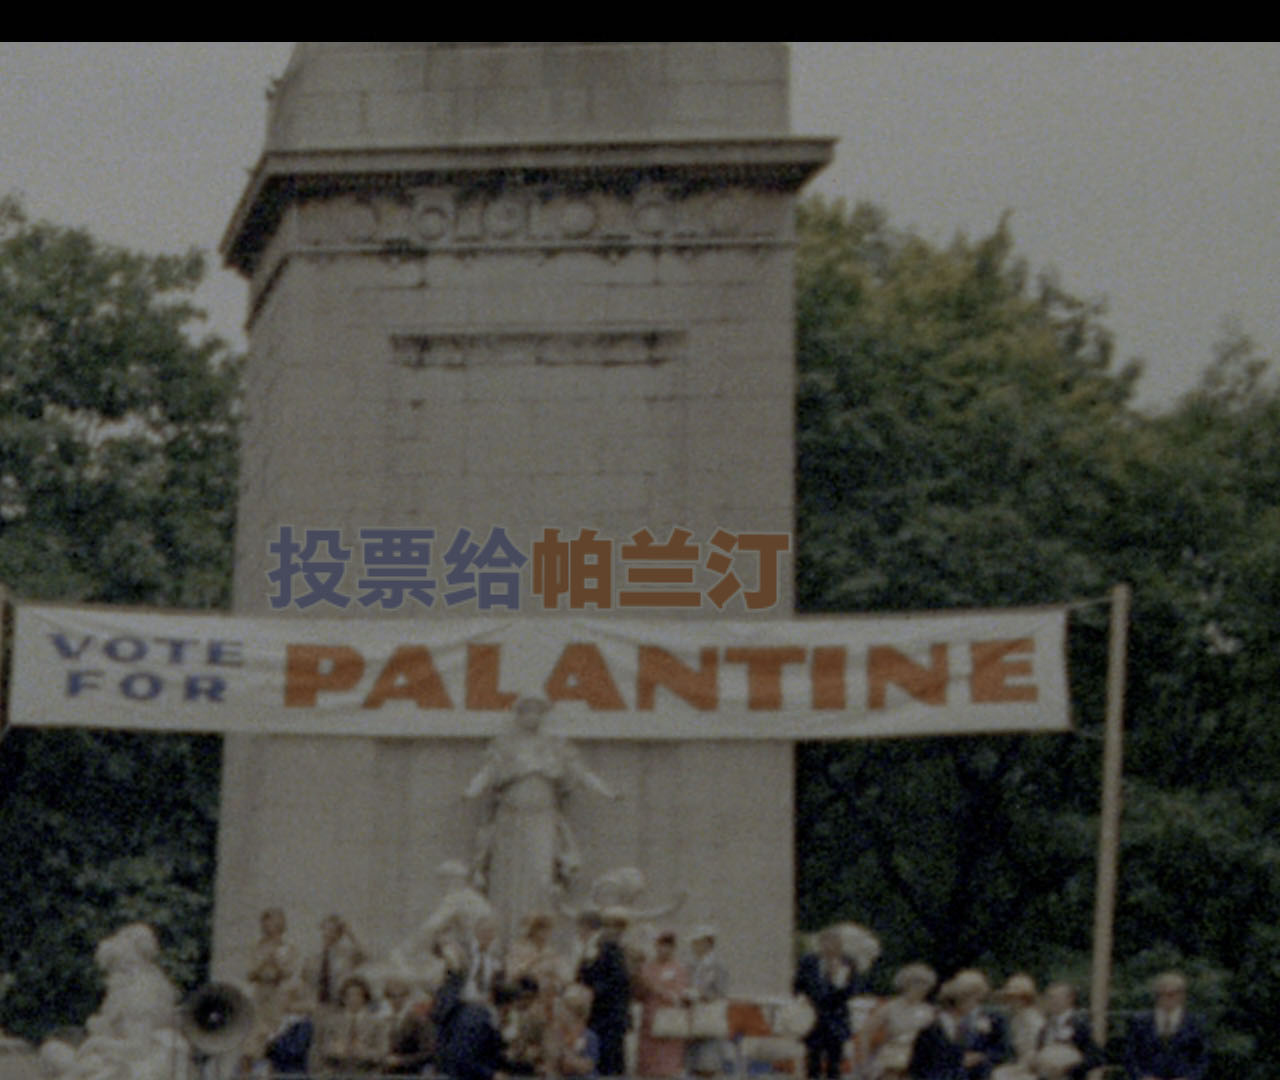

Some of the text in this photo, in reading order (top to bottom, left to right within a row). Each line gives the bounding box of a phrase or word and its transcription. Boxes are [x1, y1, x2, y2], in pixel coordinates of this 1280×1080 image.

[50, 633, 244, 670] VOTE
[63, 670, 227, 704] FOR
[283, 637, 1039, 712] PALANTINE
